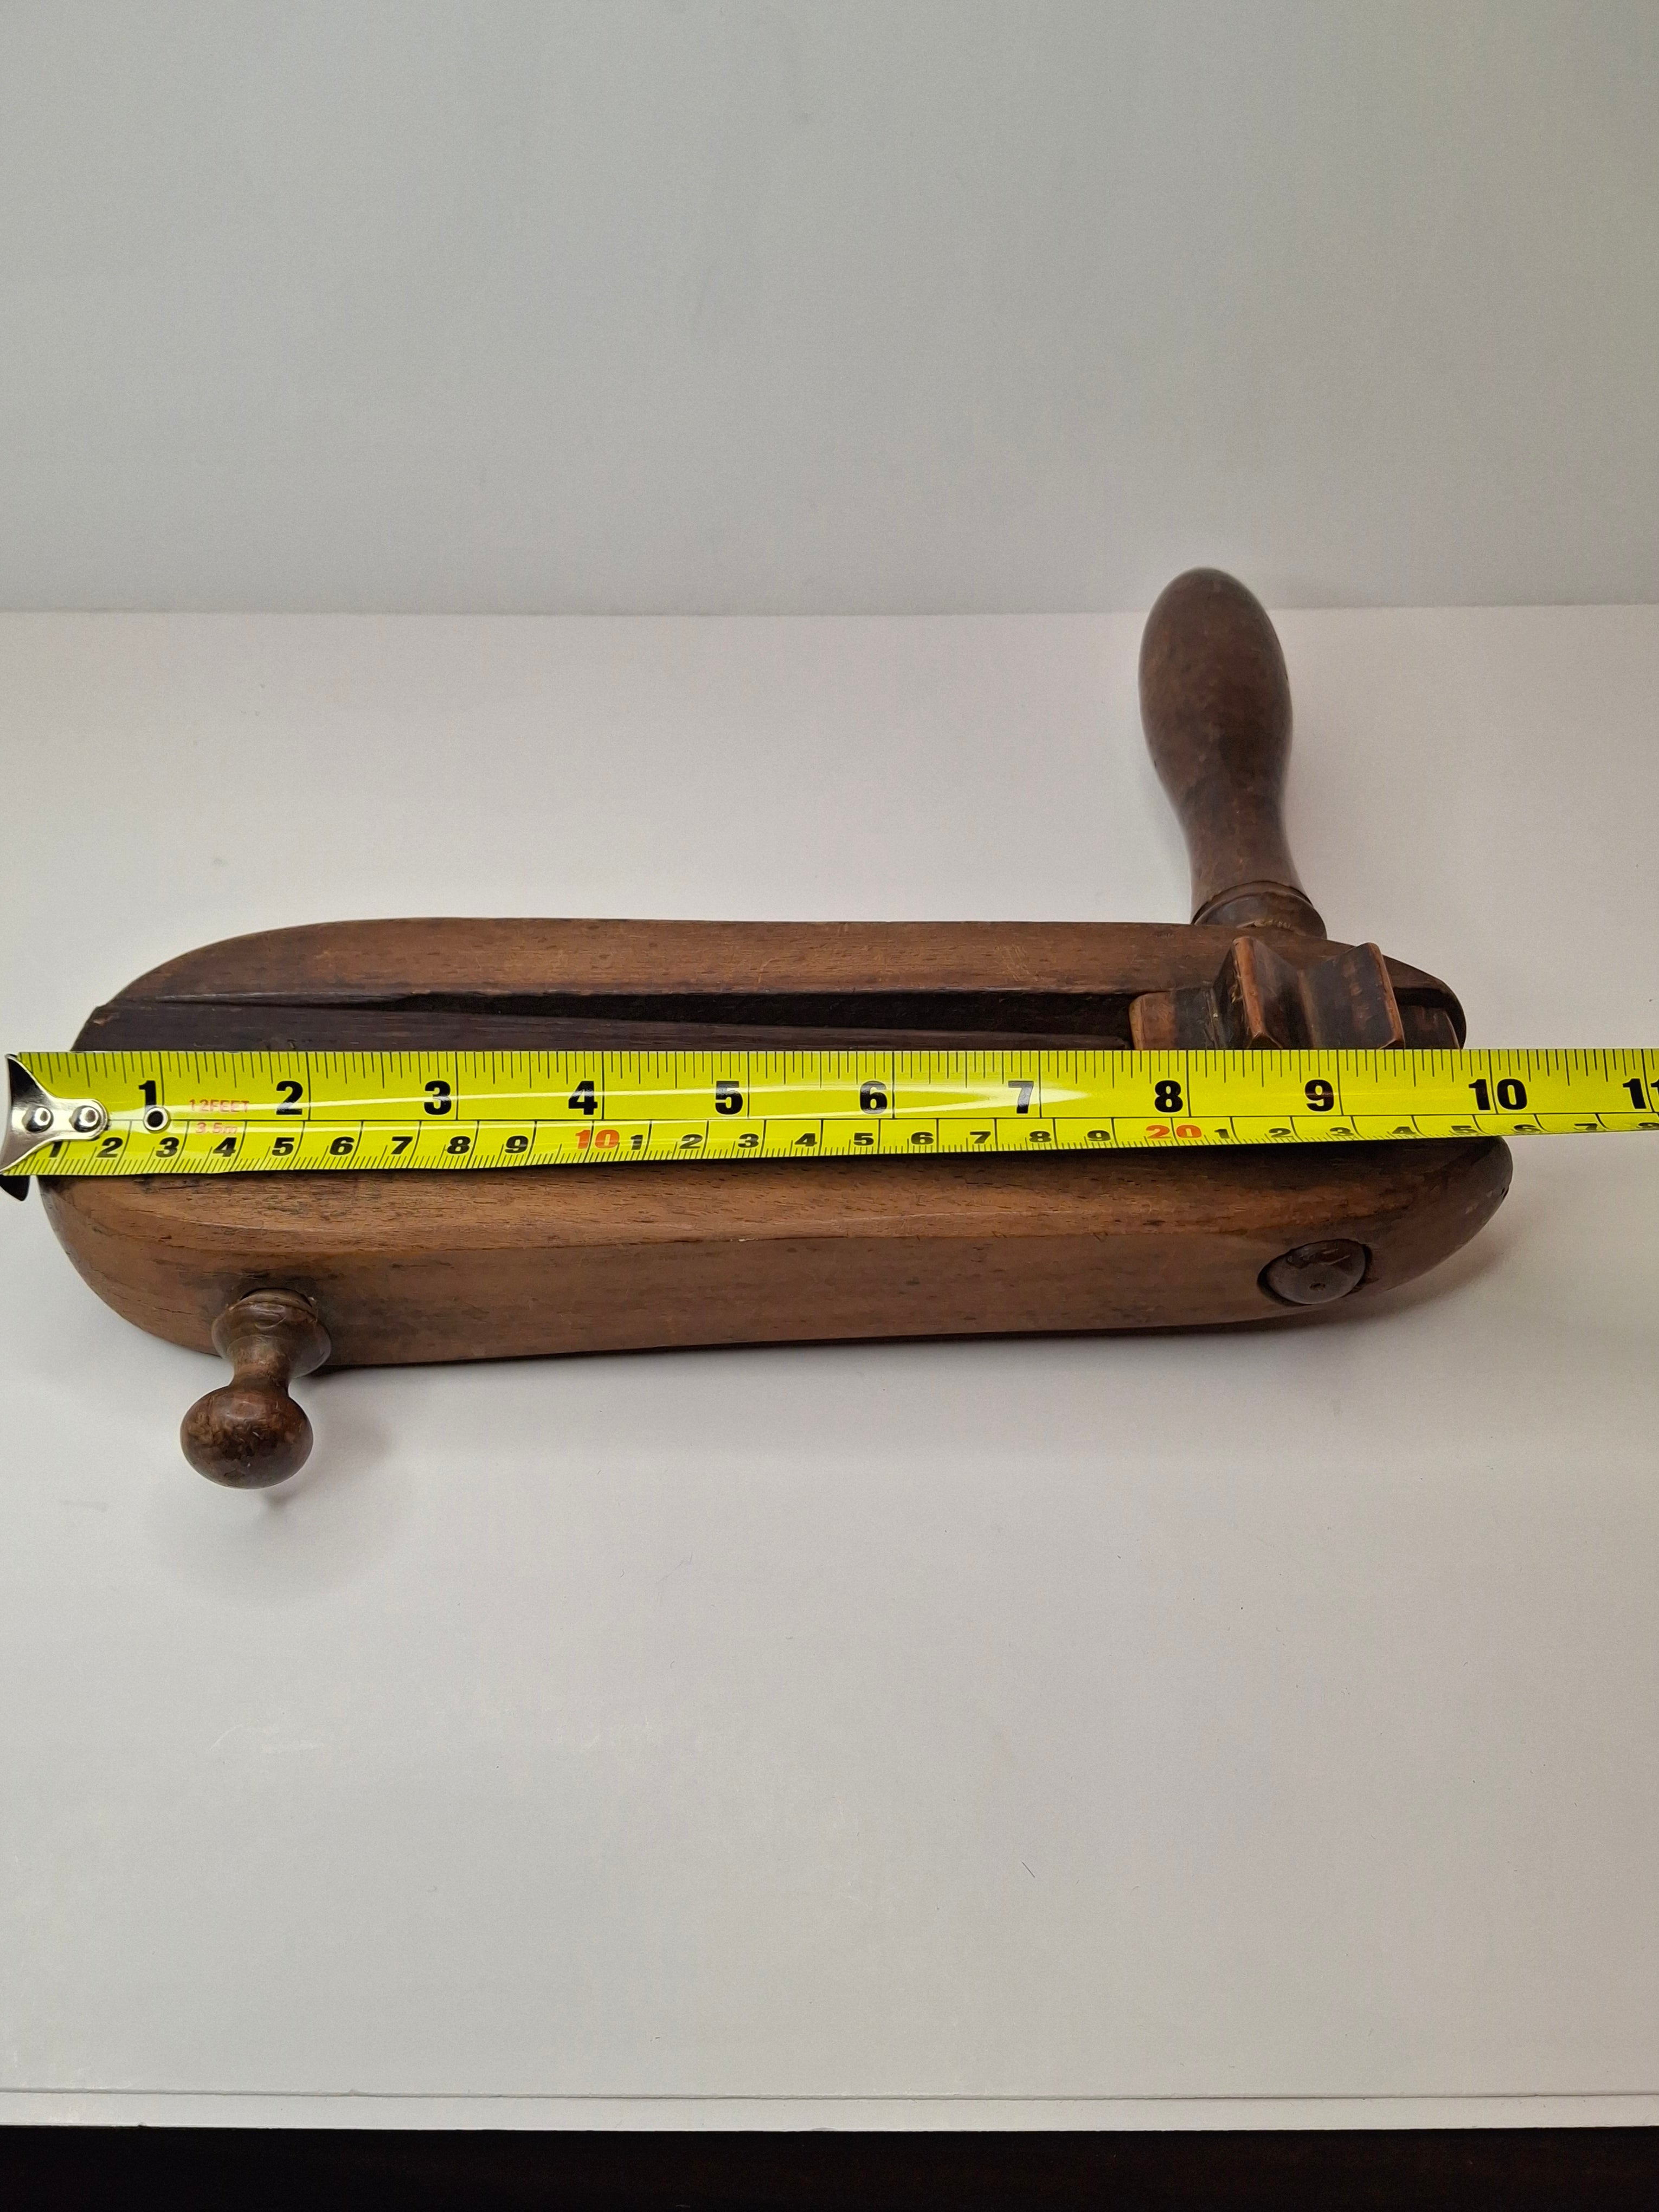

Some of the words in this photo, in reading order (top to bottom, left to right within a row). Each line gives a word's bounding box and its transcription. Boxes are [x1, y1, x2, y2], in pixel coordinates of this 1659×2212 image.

[139, 1081, 157, 1107] 1
[276, 1081, 303, 1115] 2
[424, 1081, 451, 1115] 3
[568, 1081, 598, 1115] 4
[715, 1081, 743, 1114] 5
[860, 1081, 888, 1114] 6
[1008, 1081, 1034, 1114] 7
[1155, 1080, 1183, 1113] 8
[1304, 1079, 1334, 1111] 9
[1469, 1078, 1527, 1110] 10
[96, 1137, 123, 1158] 2
[156, 1137, 179, 1158] 3
[213, 1137, 237, 1157] 4
[272, 1137, 295, 1156] 5
[329, 1136, 355, 1155] 6
[391, 1136, 413, 1154] 7
[447, 1136, 471, 1154] 8
[504, 1135, 529, 1153] 9
[575, 1129, 620, 1149] 10
[630, 1134, 644, 1150] 1
[679, 1134, 703, 1149] 2
[738, 1133, 758, 1148] 3
[795, 1133, 817, 1147] 4
[853, 1133, 874, 1146] 5
[911, 1131, 934, 1144] 6
[970, 1131, 991, 1143] 7
[1029, 1130, 1051, 1142] 8
[1087, 1130, 1110, 1141] 9
[1146, 1124, 1202, 1139] 20
[1214, 1128, 1230, 1139] 1
[1269, 1128, 1291, 1138] 2
[1329, 1127, 1354, 1136] 3
[1392, 1126, 1416, 1134] 4
[1451, 1126, 1478, 1134] 5
